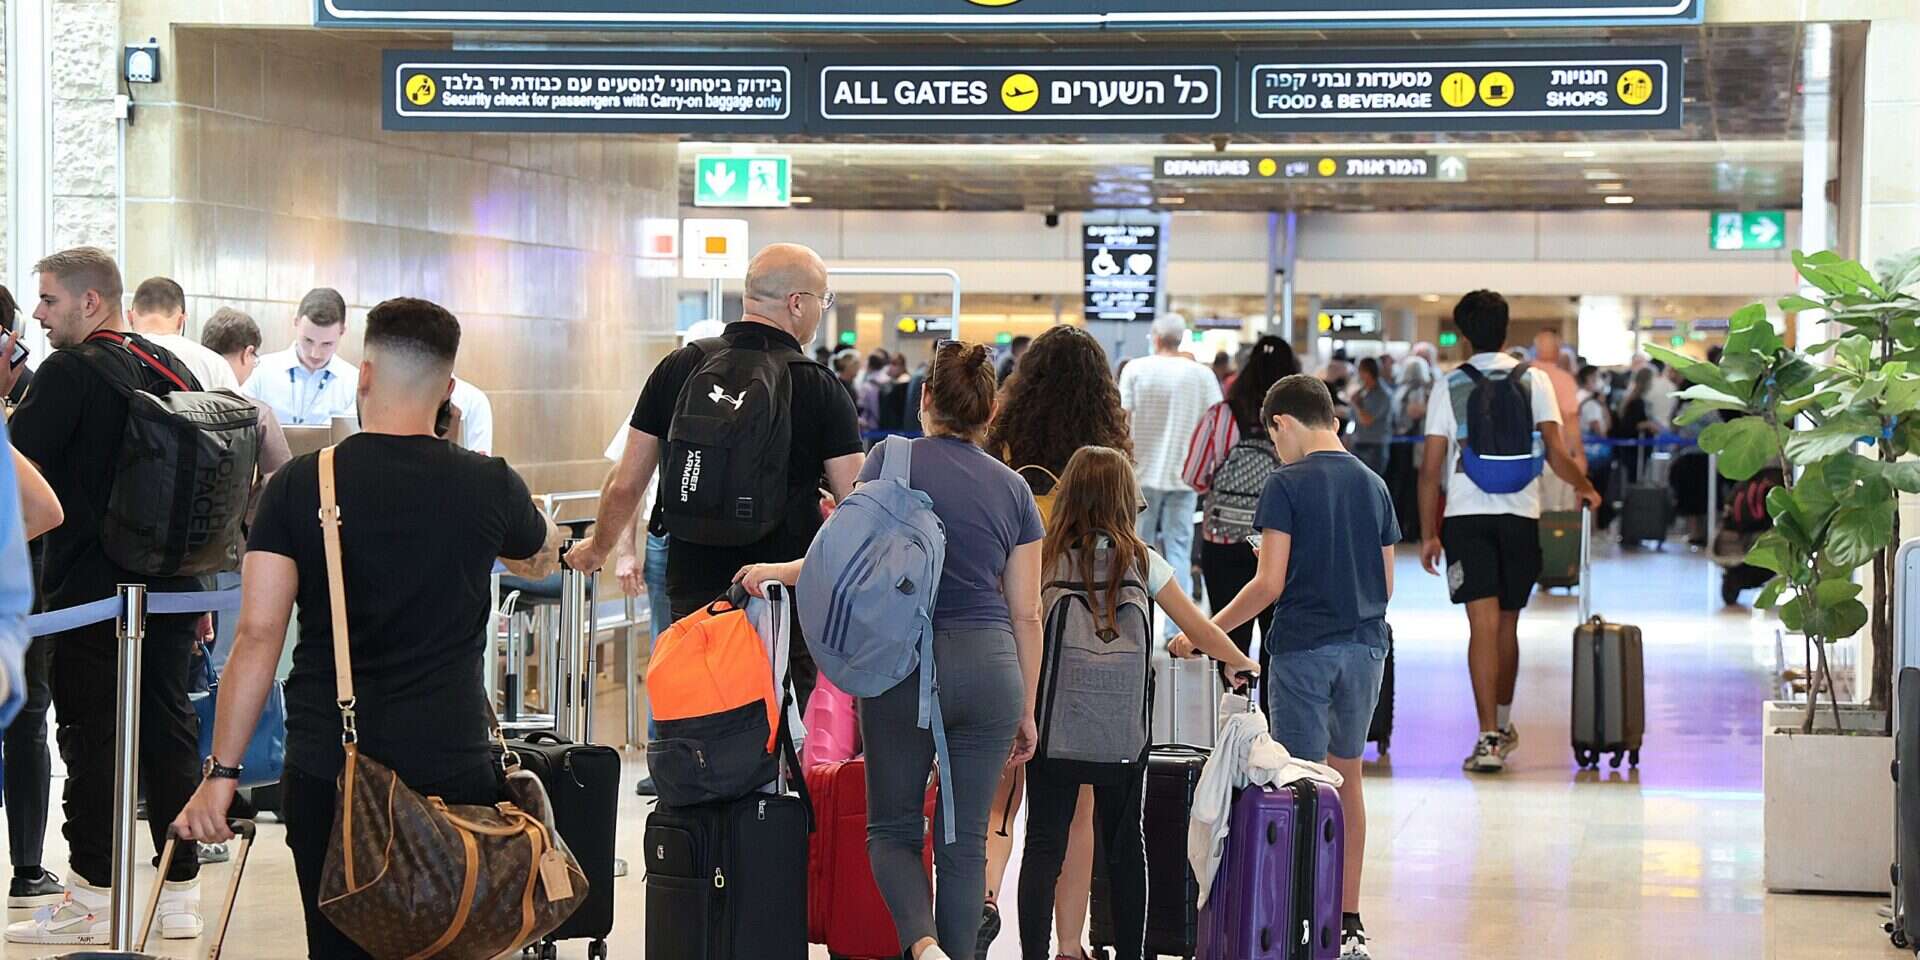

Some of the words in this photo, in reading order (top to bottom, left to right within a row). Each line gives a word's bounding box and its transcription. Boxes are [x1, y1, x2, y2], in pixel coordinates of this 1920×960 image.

[441, 73, 484, 91] בלבד
[488, 76, 505, 90] יד
[510, 76, 562, 91] כבודת
[567, 77, 592, 93] עם
[597, 74, 666, 93] לנוסעים
[670, 77, 732, 93] ביטחוני
[1266, 72, 1307, 91] קפה
[1311, 72, 1351, 88] ובתי
[1356, 71, 1432, 89] מסעדות
[1551, 69, 1608, 86] חנויות
[737, 78, 783, 96] בידוק
[832, 80, 888, 105] ALL
[894, 80, 988, 106] GATES
[1051, 80, 1164, 107] השערים
[1173, 74, 1209, 105] כל
[441, 91, 492, 109] Security
[494, 92, 530, 107] check
[531, 92, 550, 107] for
[551, 95, 621, 110] passengers
[622, 93, 648, 108] with
[650, 93, 703, 111] Carry-on
[704, 93, 753, 112] baggage
[755, 94, 782, 111] only
[1267, 94, 1317, 109] FOOD
[1320, 94, 1334, 109] &
[1337, 93, 1433, 109] BEVERAGE
[1546, 90, 1609, 107] SHOPS
[1163, 159, 1250, 176] DEPARTURES
[1346, 158, 1428, 176] המראות
[680, 450, 695, 503] ARMOUR
[689, 450, 702, 492] UNDER
